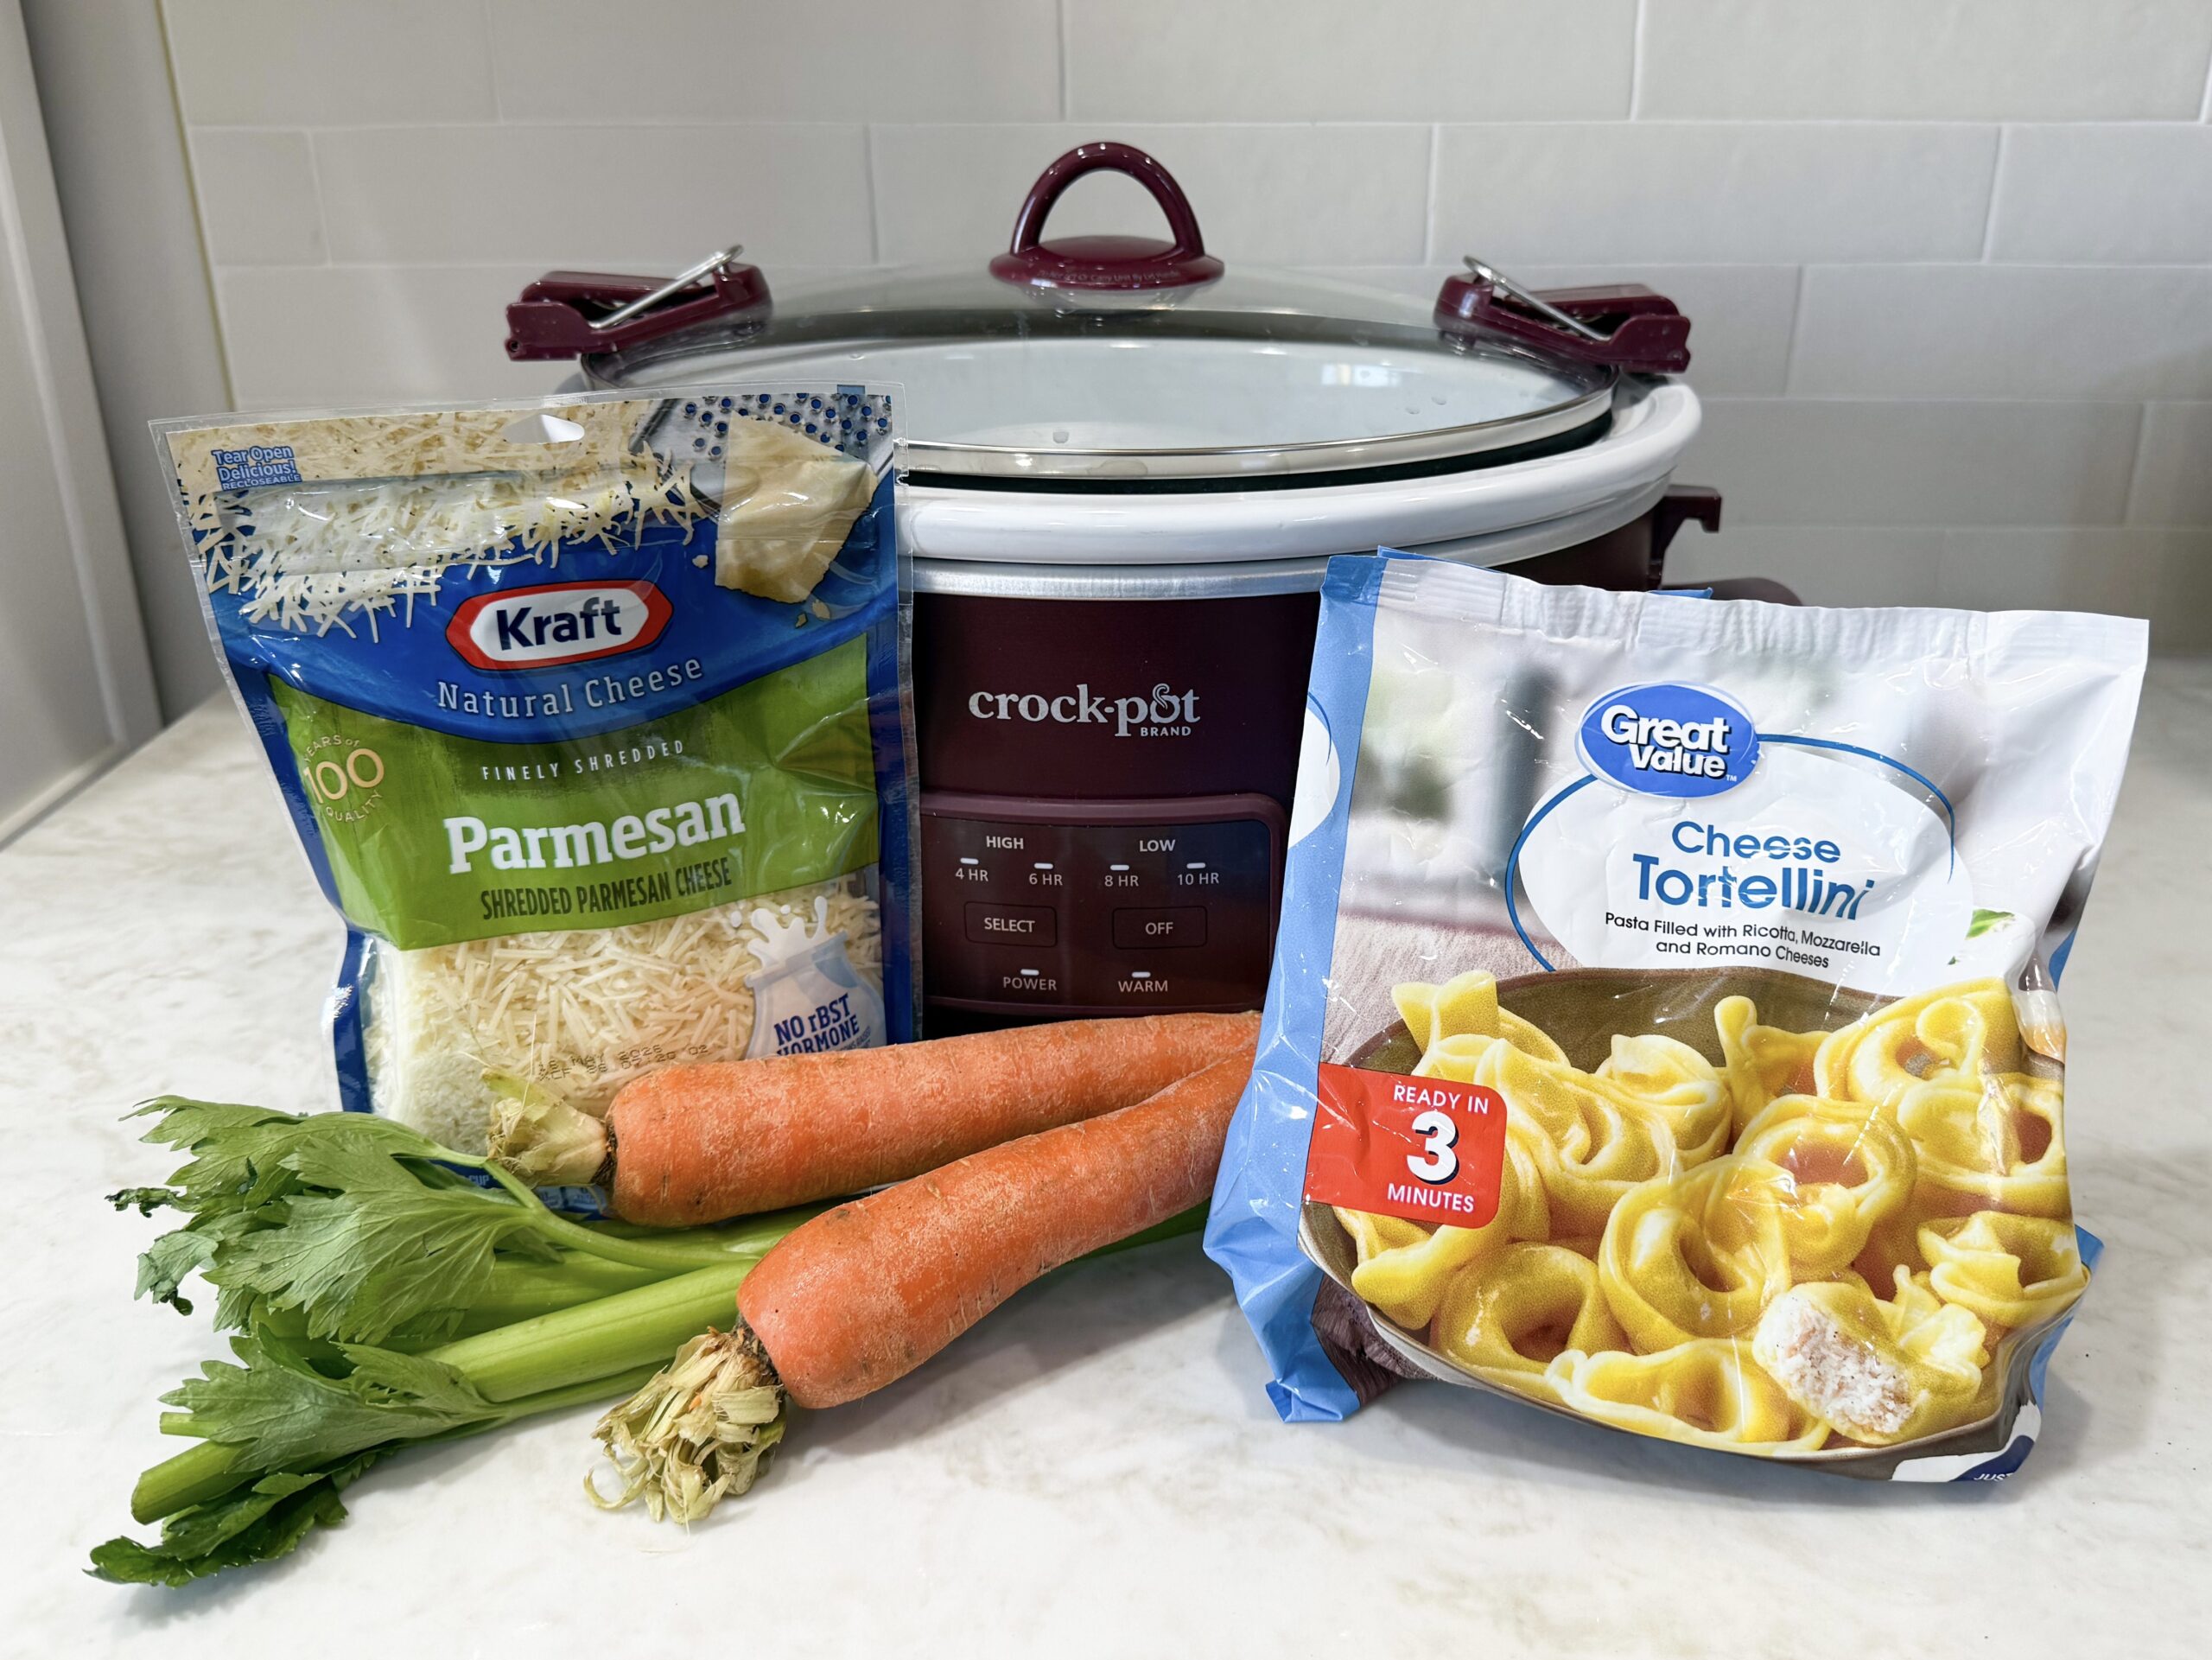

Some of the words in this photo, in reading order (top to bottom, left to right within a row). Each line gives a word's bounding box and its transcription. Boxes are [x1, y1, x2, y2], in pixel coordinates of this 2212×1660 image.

[212, 449, 248, 465] Tear
[250, 446, 293, 461] Open
[218, 461, 296, 480] Delicious!
[222, 474, 302, 490] RECLOSEABLE
[496, 597, 621, 651] Kraft
[437, 681, 573, 718] Natural
[585, 658, 703, 709] Cheese
[969, 683, 1200, 737] crock-pot
[1140, 726, 1192, 737] BRAND
[1601, 704, 1730, 754] Great
[304, 735, 342, 762] YEARS
[482, 761, 559, 781] FINELY
[575, 740, 684, 774] SHREDDED
[1630, 744, 1727, 779] Value
[303, 747, 385, 804] 100
[326, 790, 383, 822] QUALITY
[443, 792, 747, 875] Parmesan
[986, 836, 1024, 850] HIGH
[1139, 839, 1176, 853] LOW
[1672, 821, 1841, 863] Cheese
[480, 887, 572, 920] SHREDDED
[577, 871, 672, 913] PARMESAN
[675, 856, 733, 897] CHEESE
[955, 868, 964, 881] 4
[967, 869, 989, 882] HR
[1029, 875, 1038, 887] 6
[1042, 875, 1064, 887] HR
[1104, 875, 1114, 887] 8
[1118, 875, 1139, 887] HR
[1177, 874, 1194, 886] 10
[1198, 872, 1220, 885] HR
[1632, 853, 1875, 921] Tortellini
[984, 918, 1035, 933] SELECT
[1145, 922, 1173, 936] OFF
[1605, 912, 1649, 932] Pasta
[1654, 919, 1698, 937] Filled
[1703, 925, 1738, 938] with
[1743, 924, 1798, 945] Ricotta,
[1801, 930, 1881, 957] Mozzarella
[1656, 939, 1691, 954] and
[1696, 944, 1771, 957] Romano
[1776, 945, 1830, 969] Cheeses
[1002, 976, 1057, 992] POWER
[1118, 979, 1169, 993] WARM
[774, 1015, 805, 1046] NO
[808, 992, 851, 1033] rBST
[619, 1044, 663, 1061] 2026
[688, 1044, 709, 1055] 02
[1393, 1084, 1462, 1110] READY
[1467, 1097, 1490, 1115] IN
[1407, 1111, 1459, 1185] 3
[1387, 1182, 1475, 1213] MINUTES
